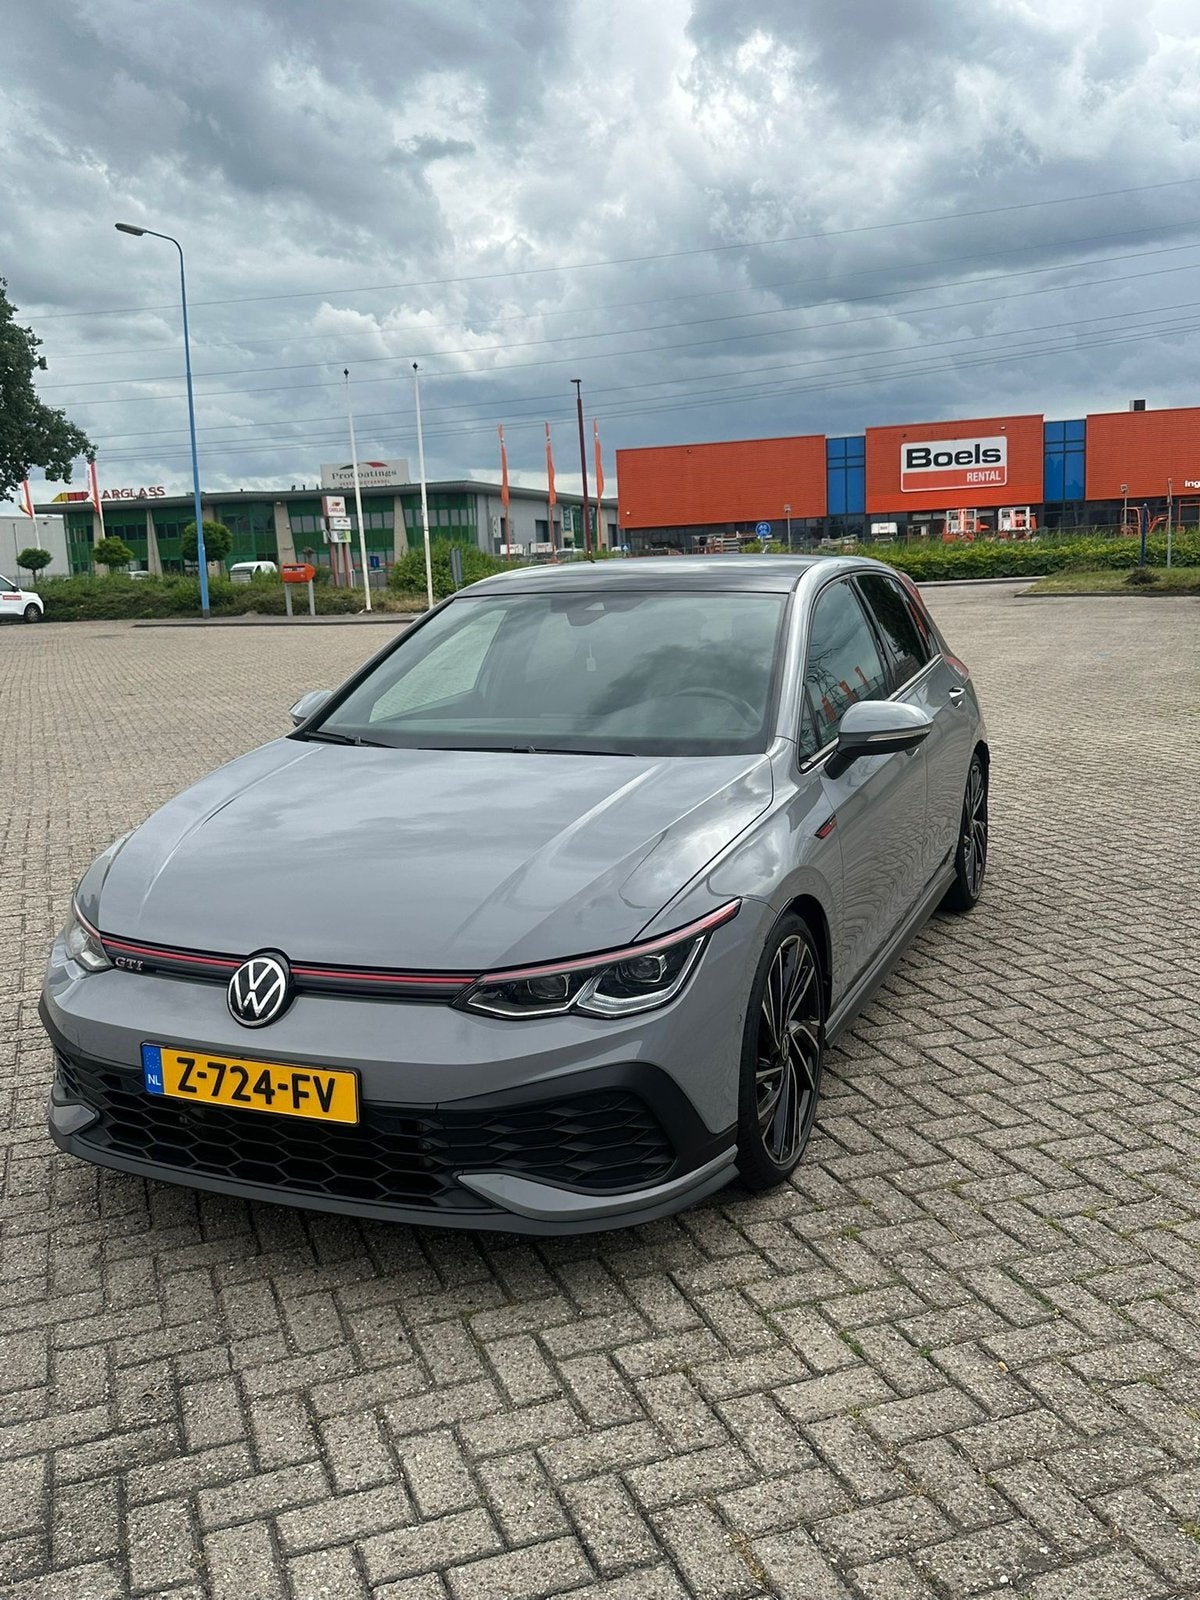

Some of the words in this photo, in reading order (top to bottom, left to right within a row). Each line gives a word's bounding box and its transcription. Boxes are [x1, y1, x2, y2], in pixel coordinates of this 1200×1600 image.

[906, 443, 1002, 469] Boels
[966, 470, 1002, 483] RENTAL
[99, 485, 166, 500] ARGLASS
[114, 956, 144, 971] GTI
[147, 1073, 162, 1087] NL
[176, 1056, 337, 1114] Z-724-FV
